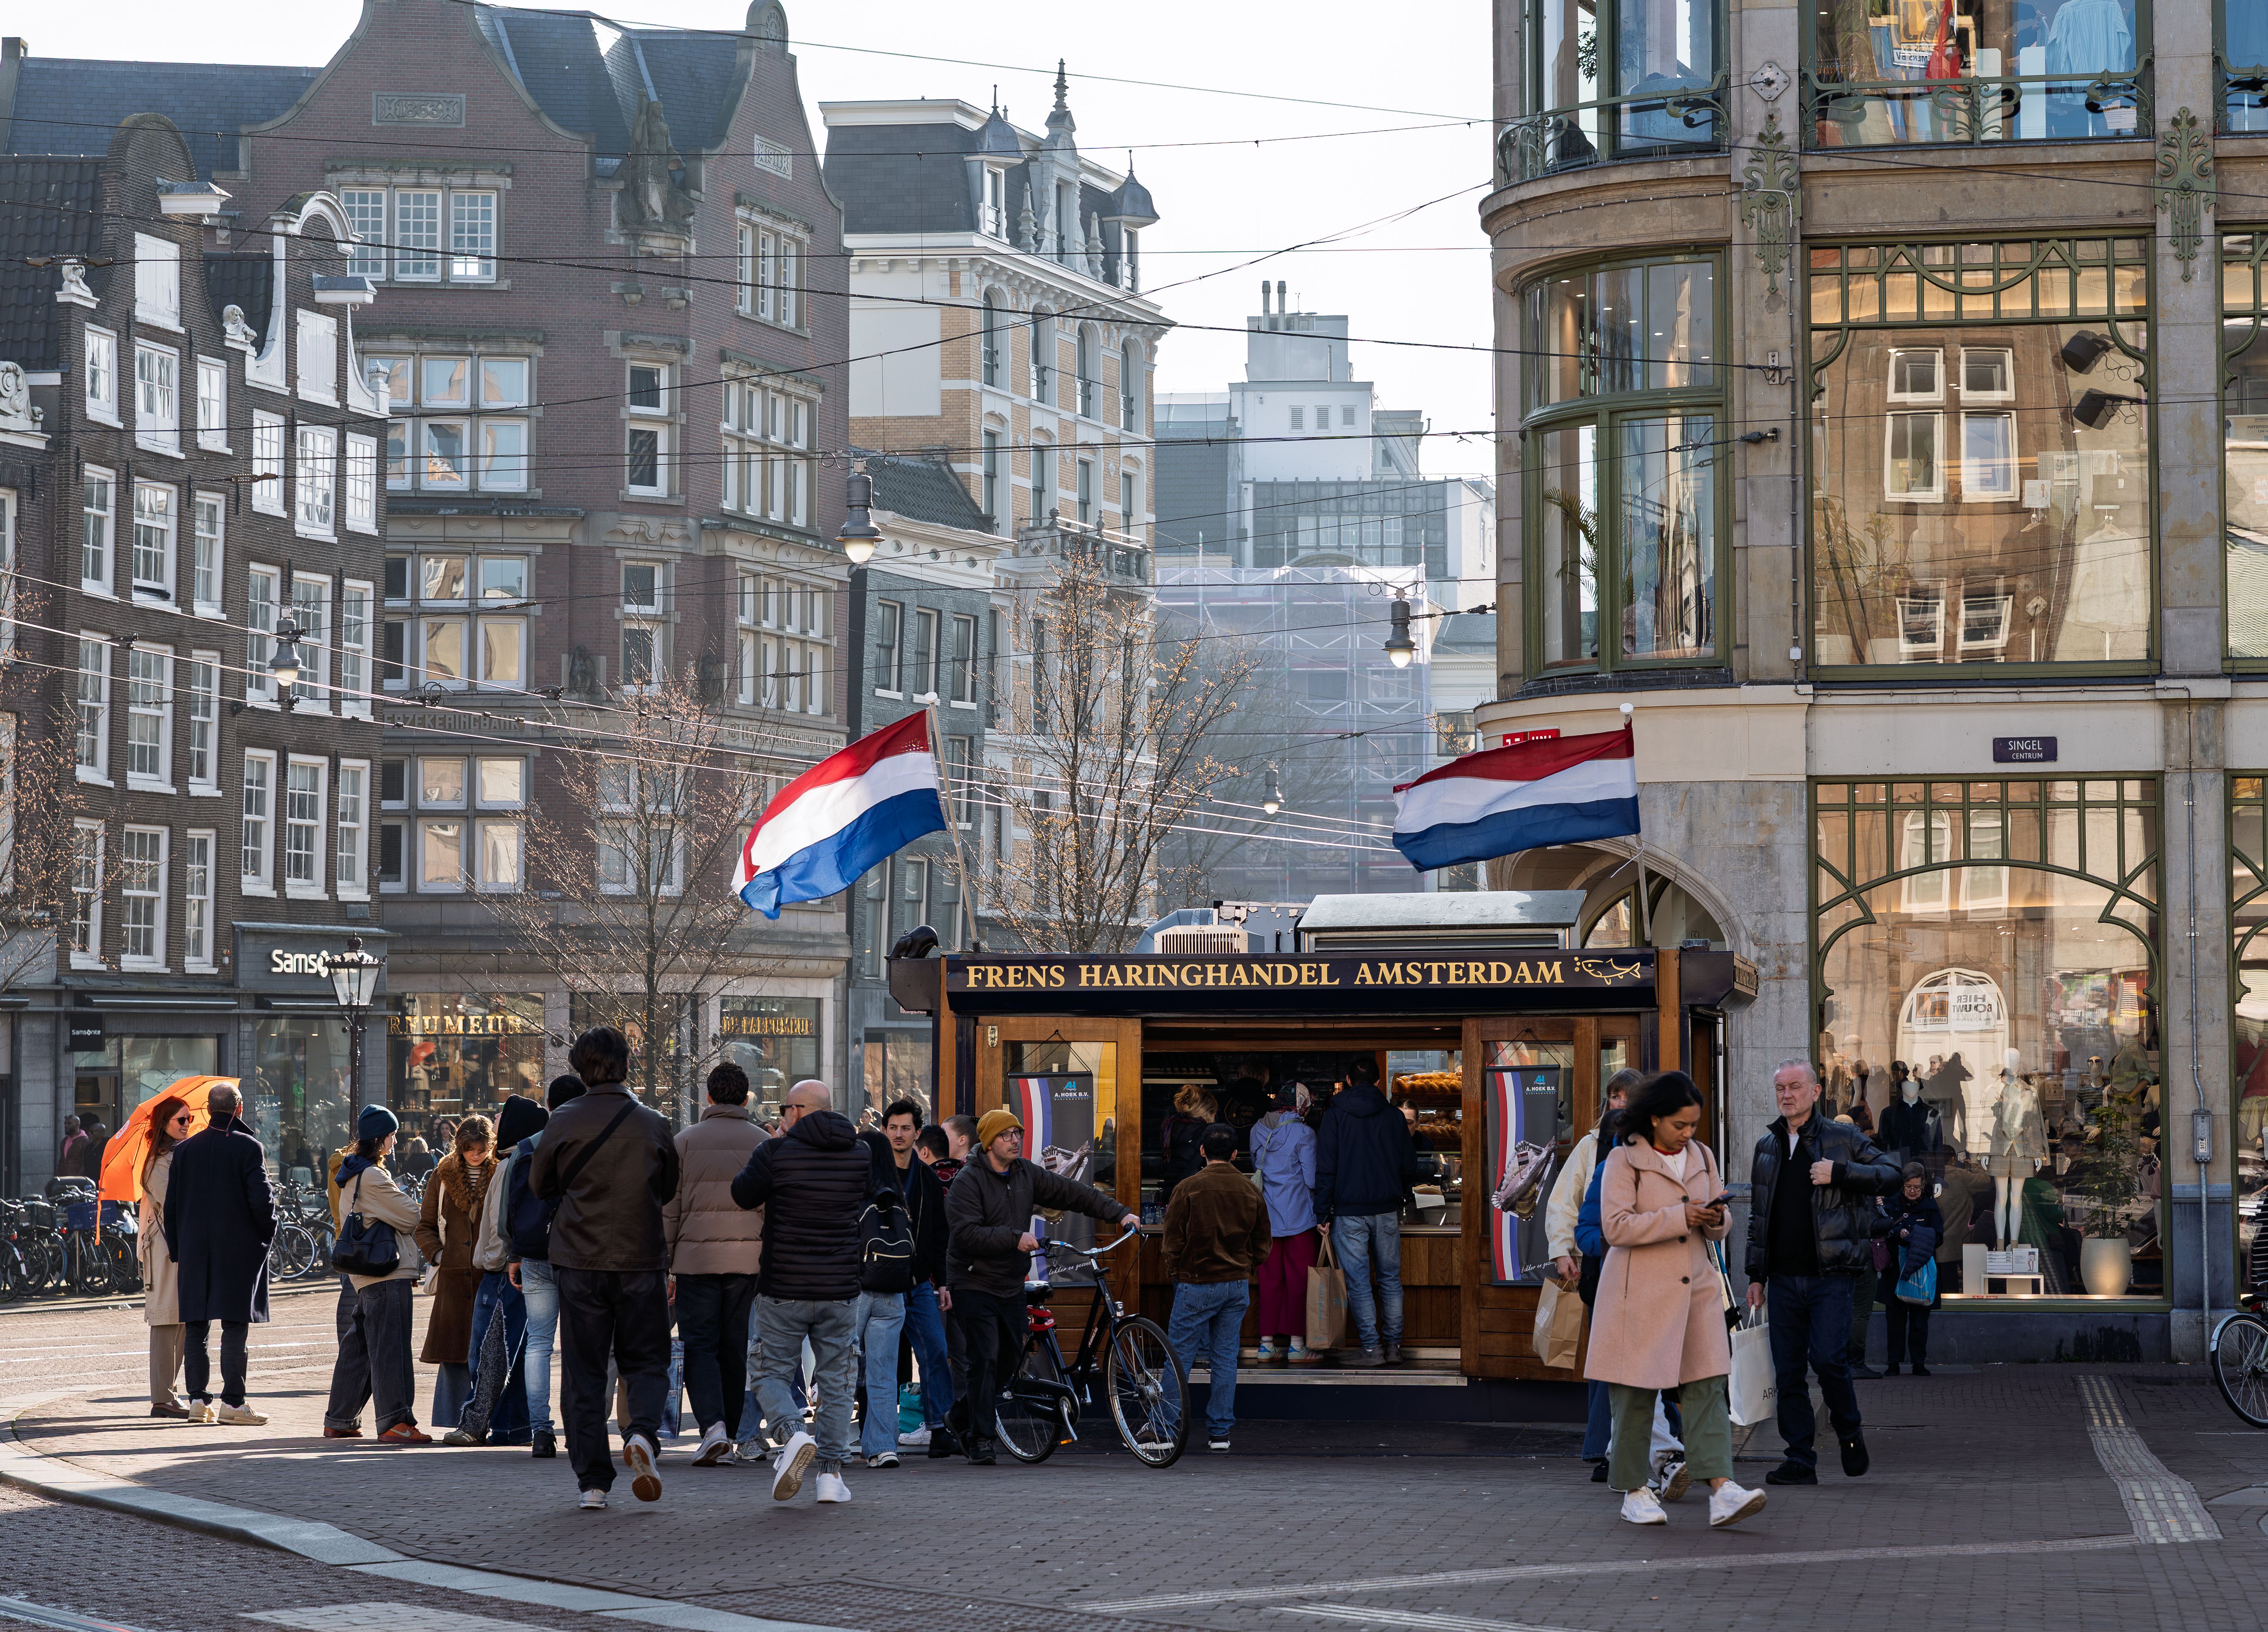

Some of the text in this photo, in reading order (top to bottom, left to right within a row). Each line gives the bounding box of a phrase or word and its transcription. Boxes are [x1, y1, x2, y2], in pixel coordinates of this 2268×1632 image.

[397, 101, 441, 118] 1863
[2009, 740, 2042, 751] SINGEL
[967, 961, 1565, 988] FRENS HARINGHANDEL AMSTERDAM
[386, 1016, 521, 1034] RFUMEUR
[751, 1060, 787, 1070] ORTO PARISI
[1049, 1266, 1067, 1275] Lekker
[1521, 1264, 1536, 1273] Lkker
[1763, 1386, 1777, 1400] ARK
